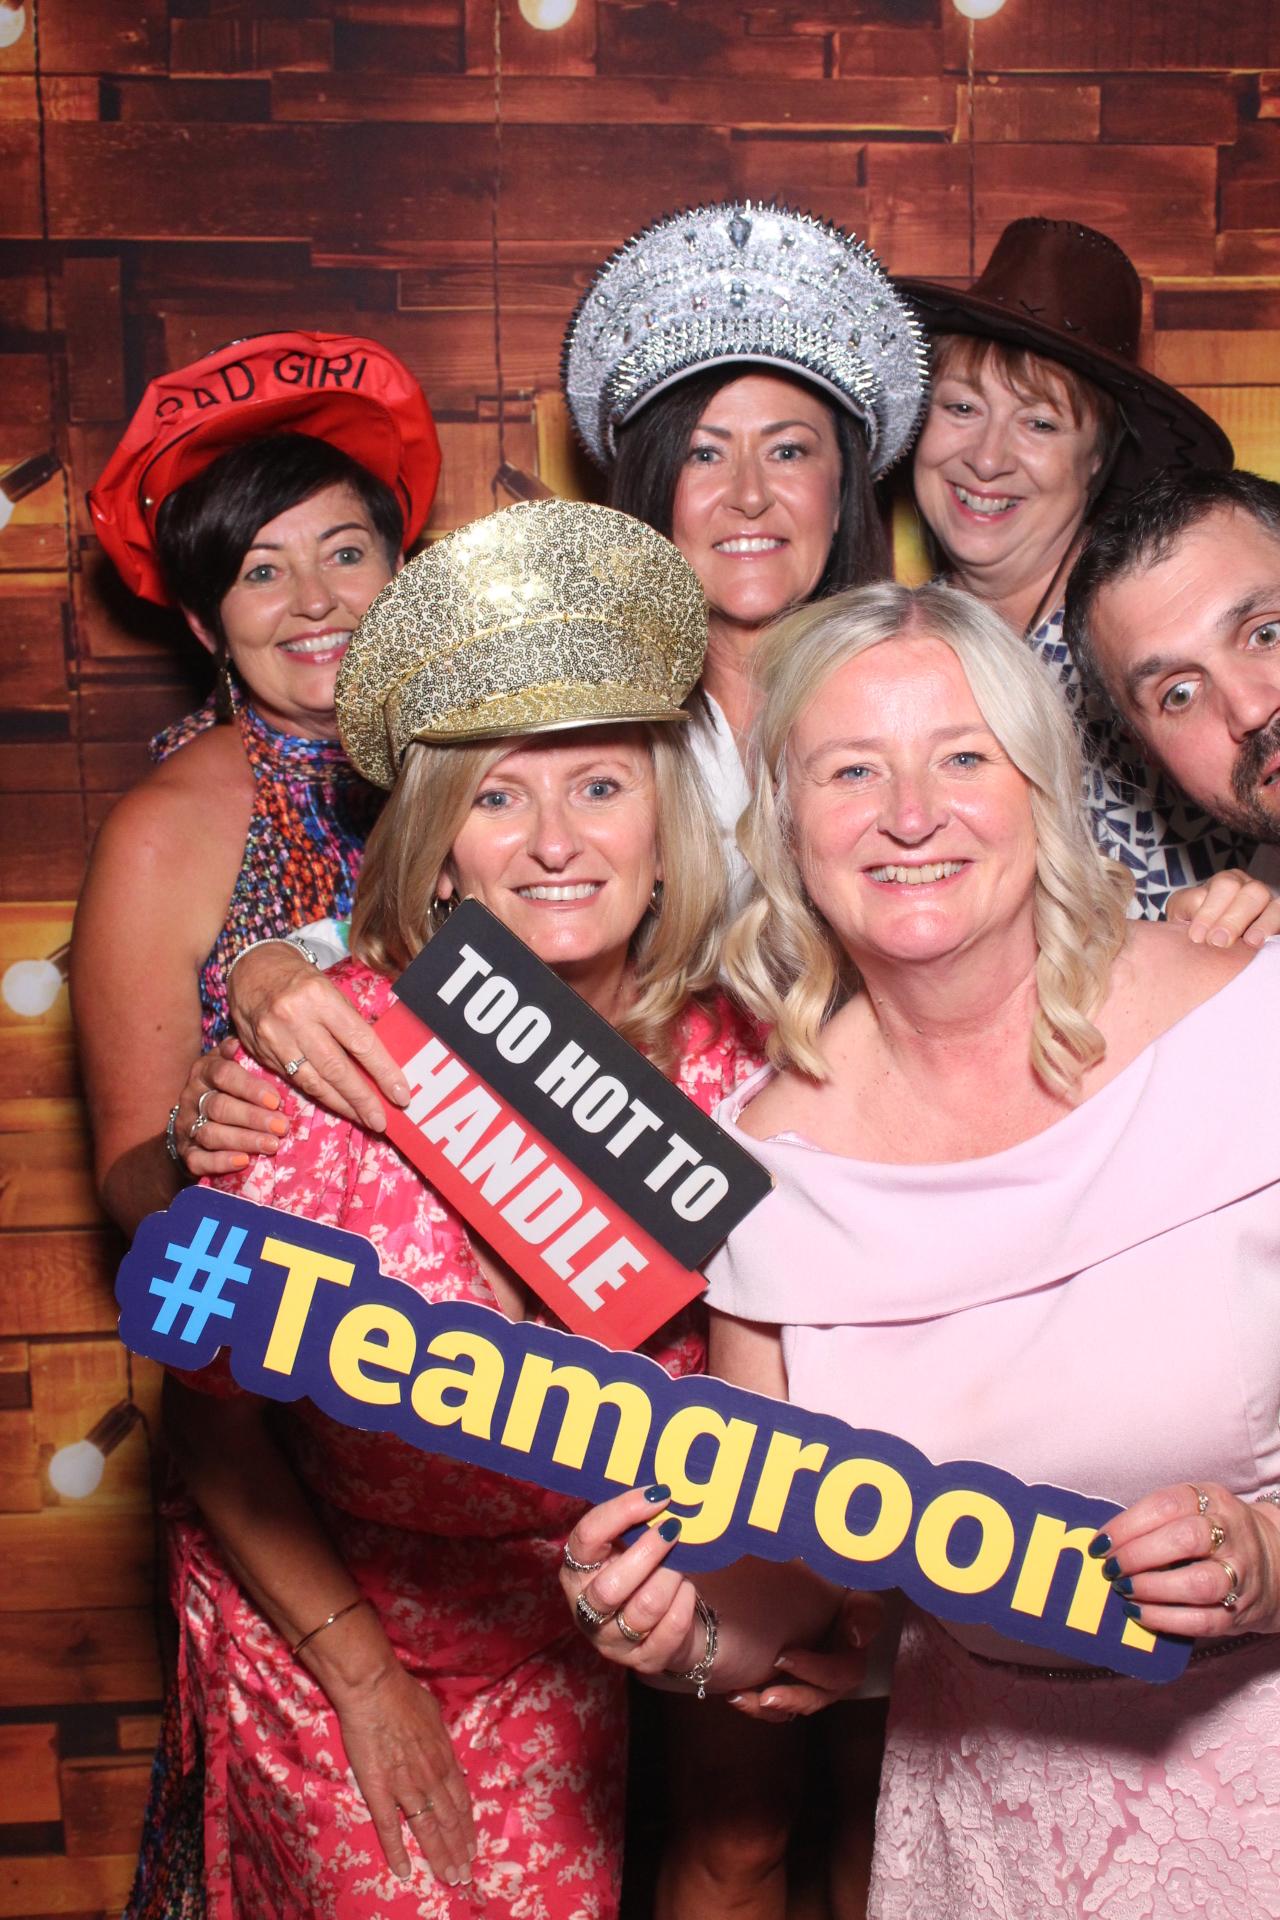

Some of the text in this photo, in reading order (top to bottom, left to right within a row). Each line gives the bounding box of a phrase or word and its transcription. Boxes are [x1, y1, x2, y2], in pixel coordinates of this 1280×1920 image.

[401, 1037, 649, 1313] HANDLE
[436, 943, 729, 1222] TOO HOT TO
